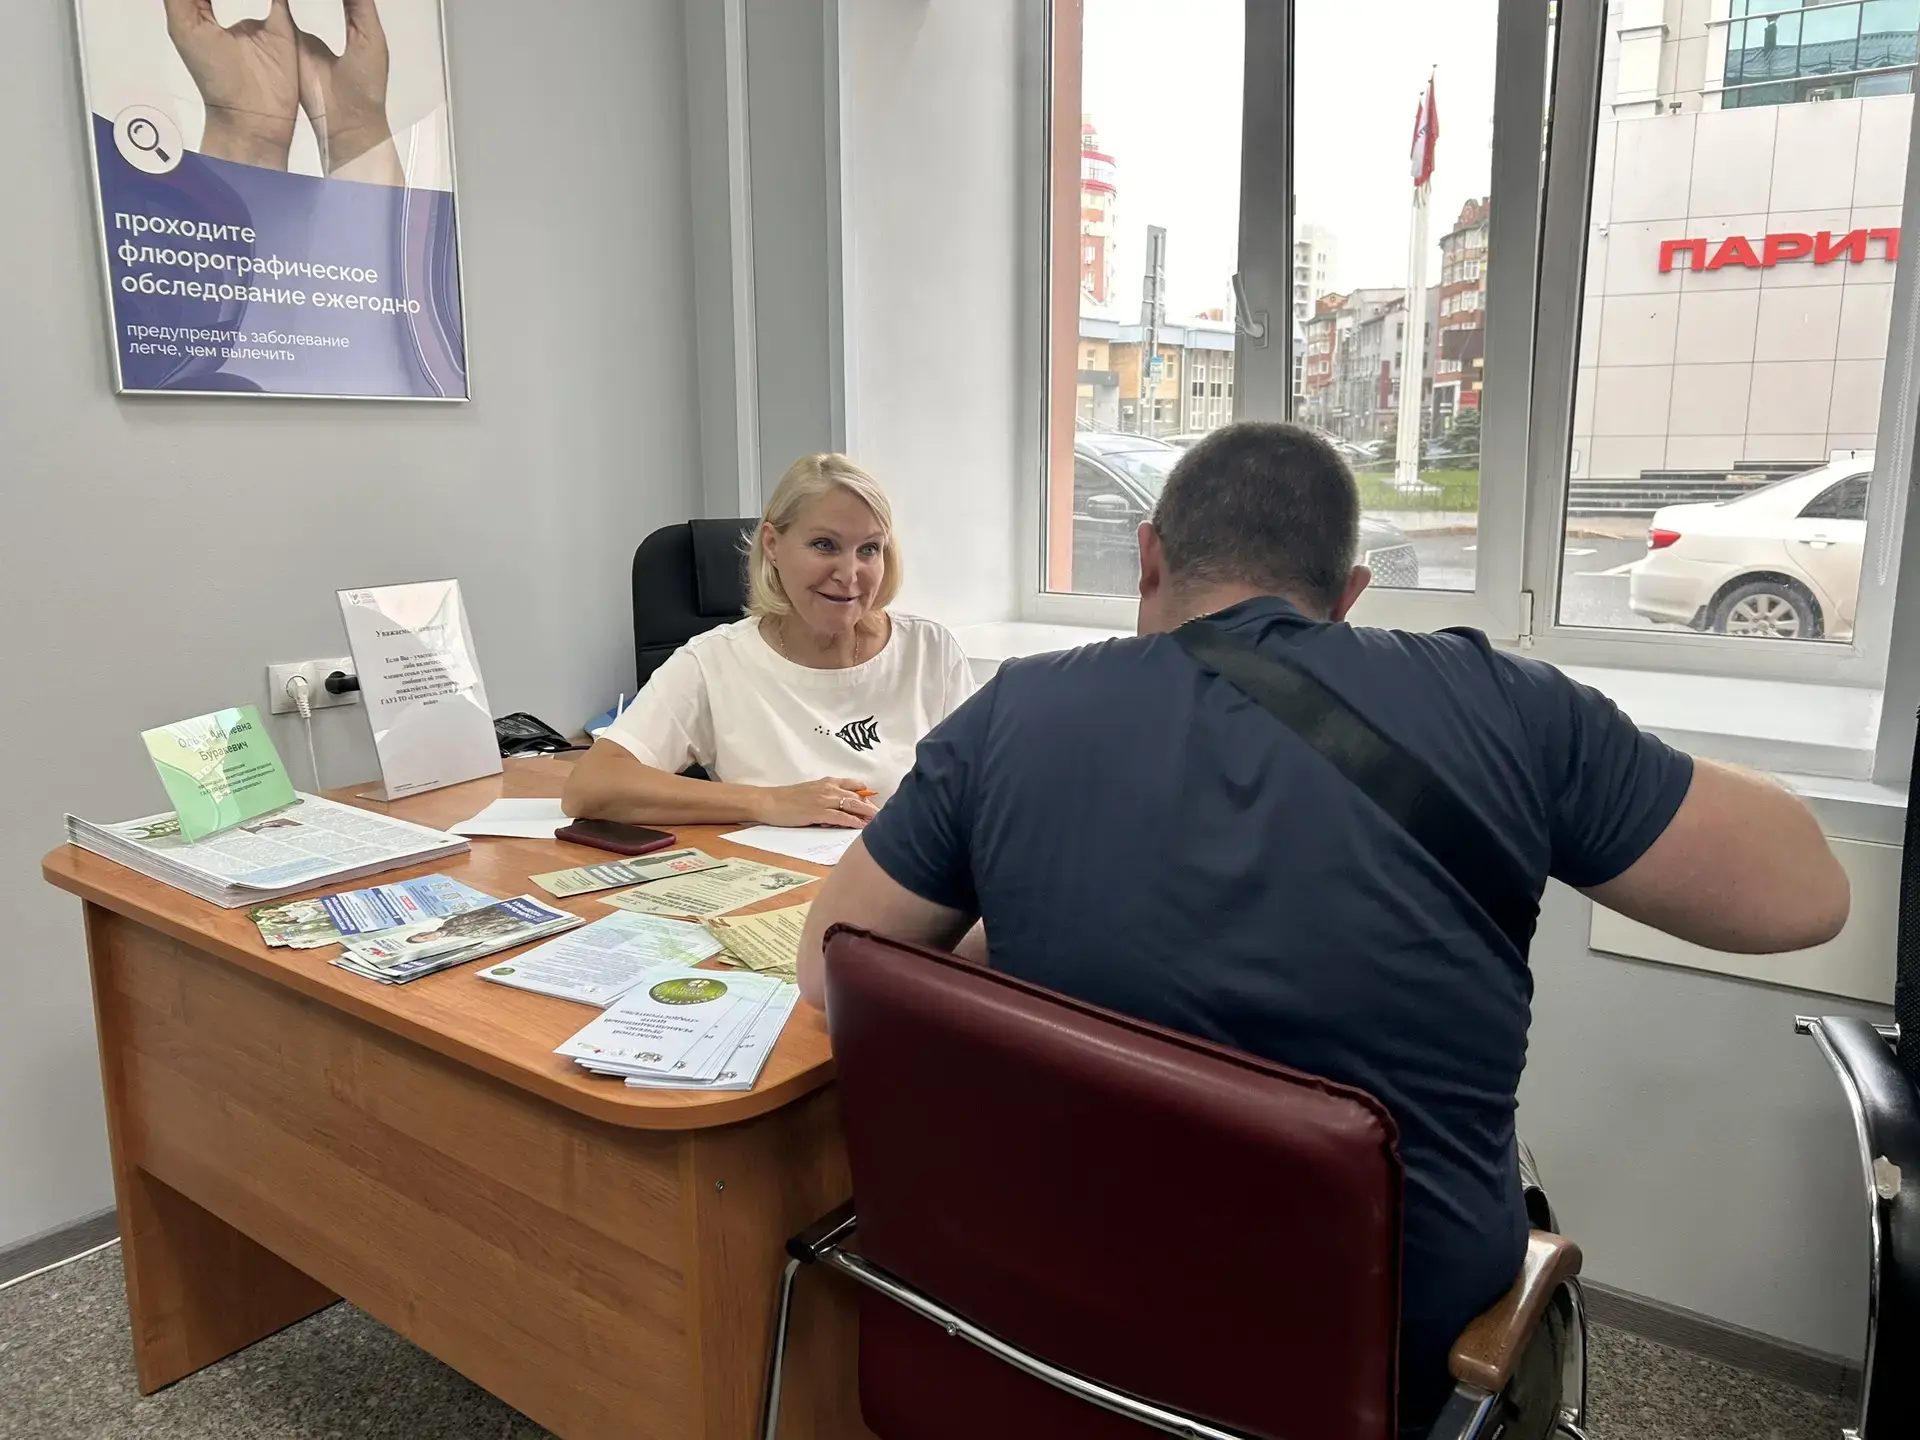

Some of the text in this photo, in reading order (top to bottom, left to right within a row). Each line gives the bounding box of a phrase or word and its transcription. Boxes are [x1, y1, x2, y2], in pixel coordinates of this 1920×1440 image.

[115, 212, 256, 243] проходите
[118, 241, 377, 283] флюорографическое
[1659, 228, 1901, 272] ПАРИТ
[121, 273, 420, 315] обследование ежегодно
[127, 323, 349, 348] предупредить заболевание
[129, 343, 295, 361] легче, чем вылечить
[376, 628, 413, 638] Уважаемы
[199, 741, 249, 761] Буракевич
[604, 1018, 694, 1033] РЕАБИЛИТАЦИОННЫЙ
